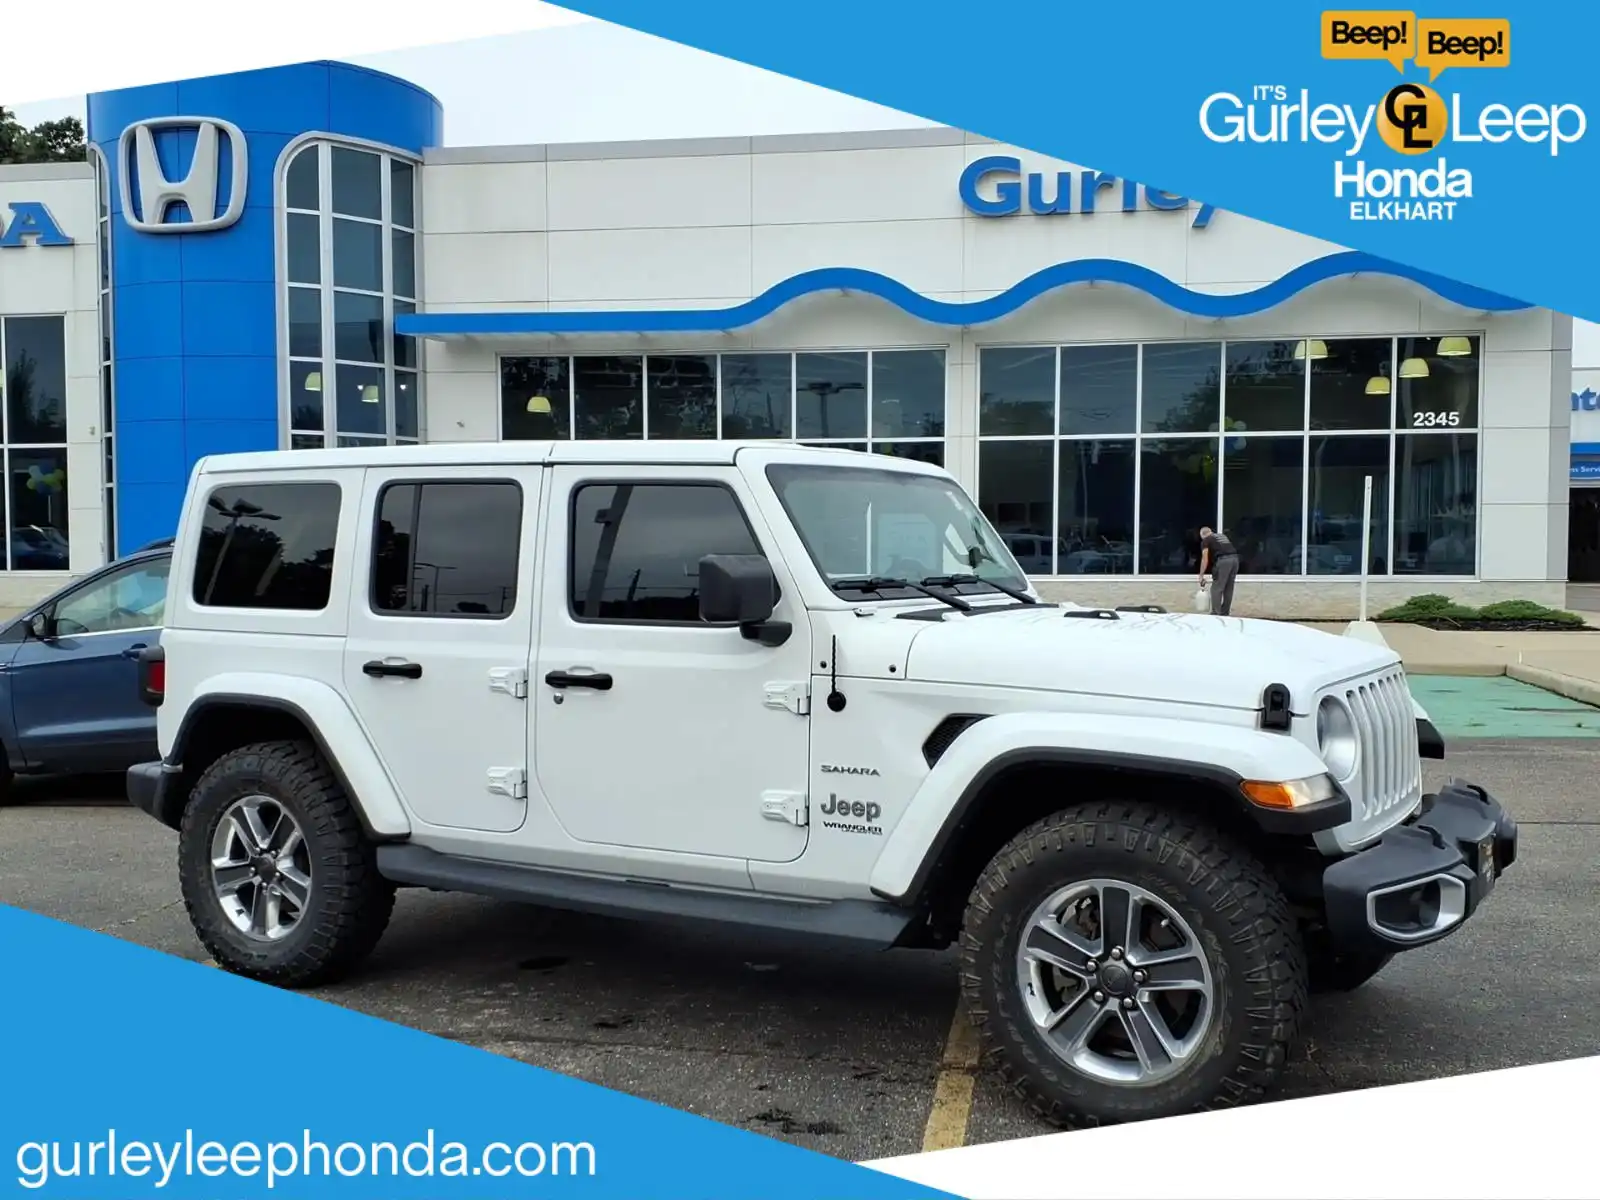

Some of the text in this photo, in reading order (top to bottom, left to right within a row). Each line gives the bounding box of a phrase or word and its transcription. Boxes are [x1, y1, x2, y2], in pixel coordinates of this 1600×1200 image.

[1413, 411, 1460, 427] 2345
[820, 764, 881, 777] SAHARA
[820, 792, 881, 822] Jeep
[822, 820, 882, 833] WRANGLER
